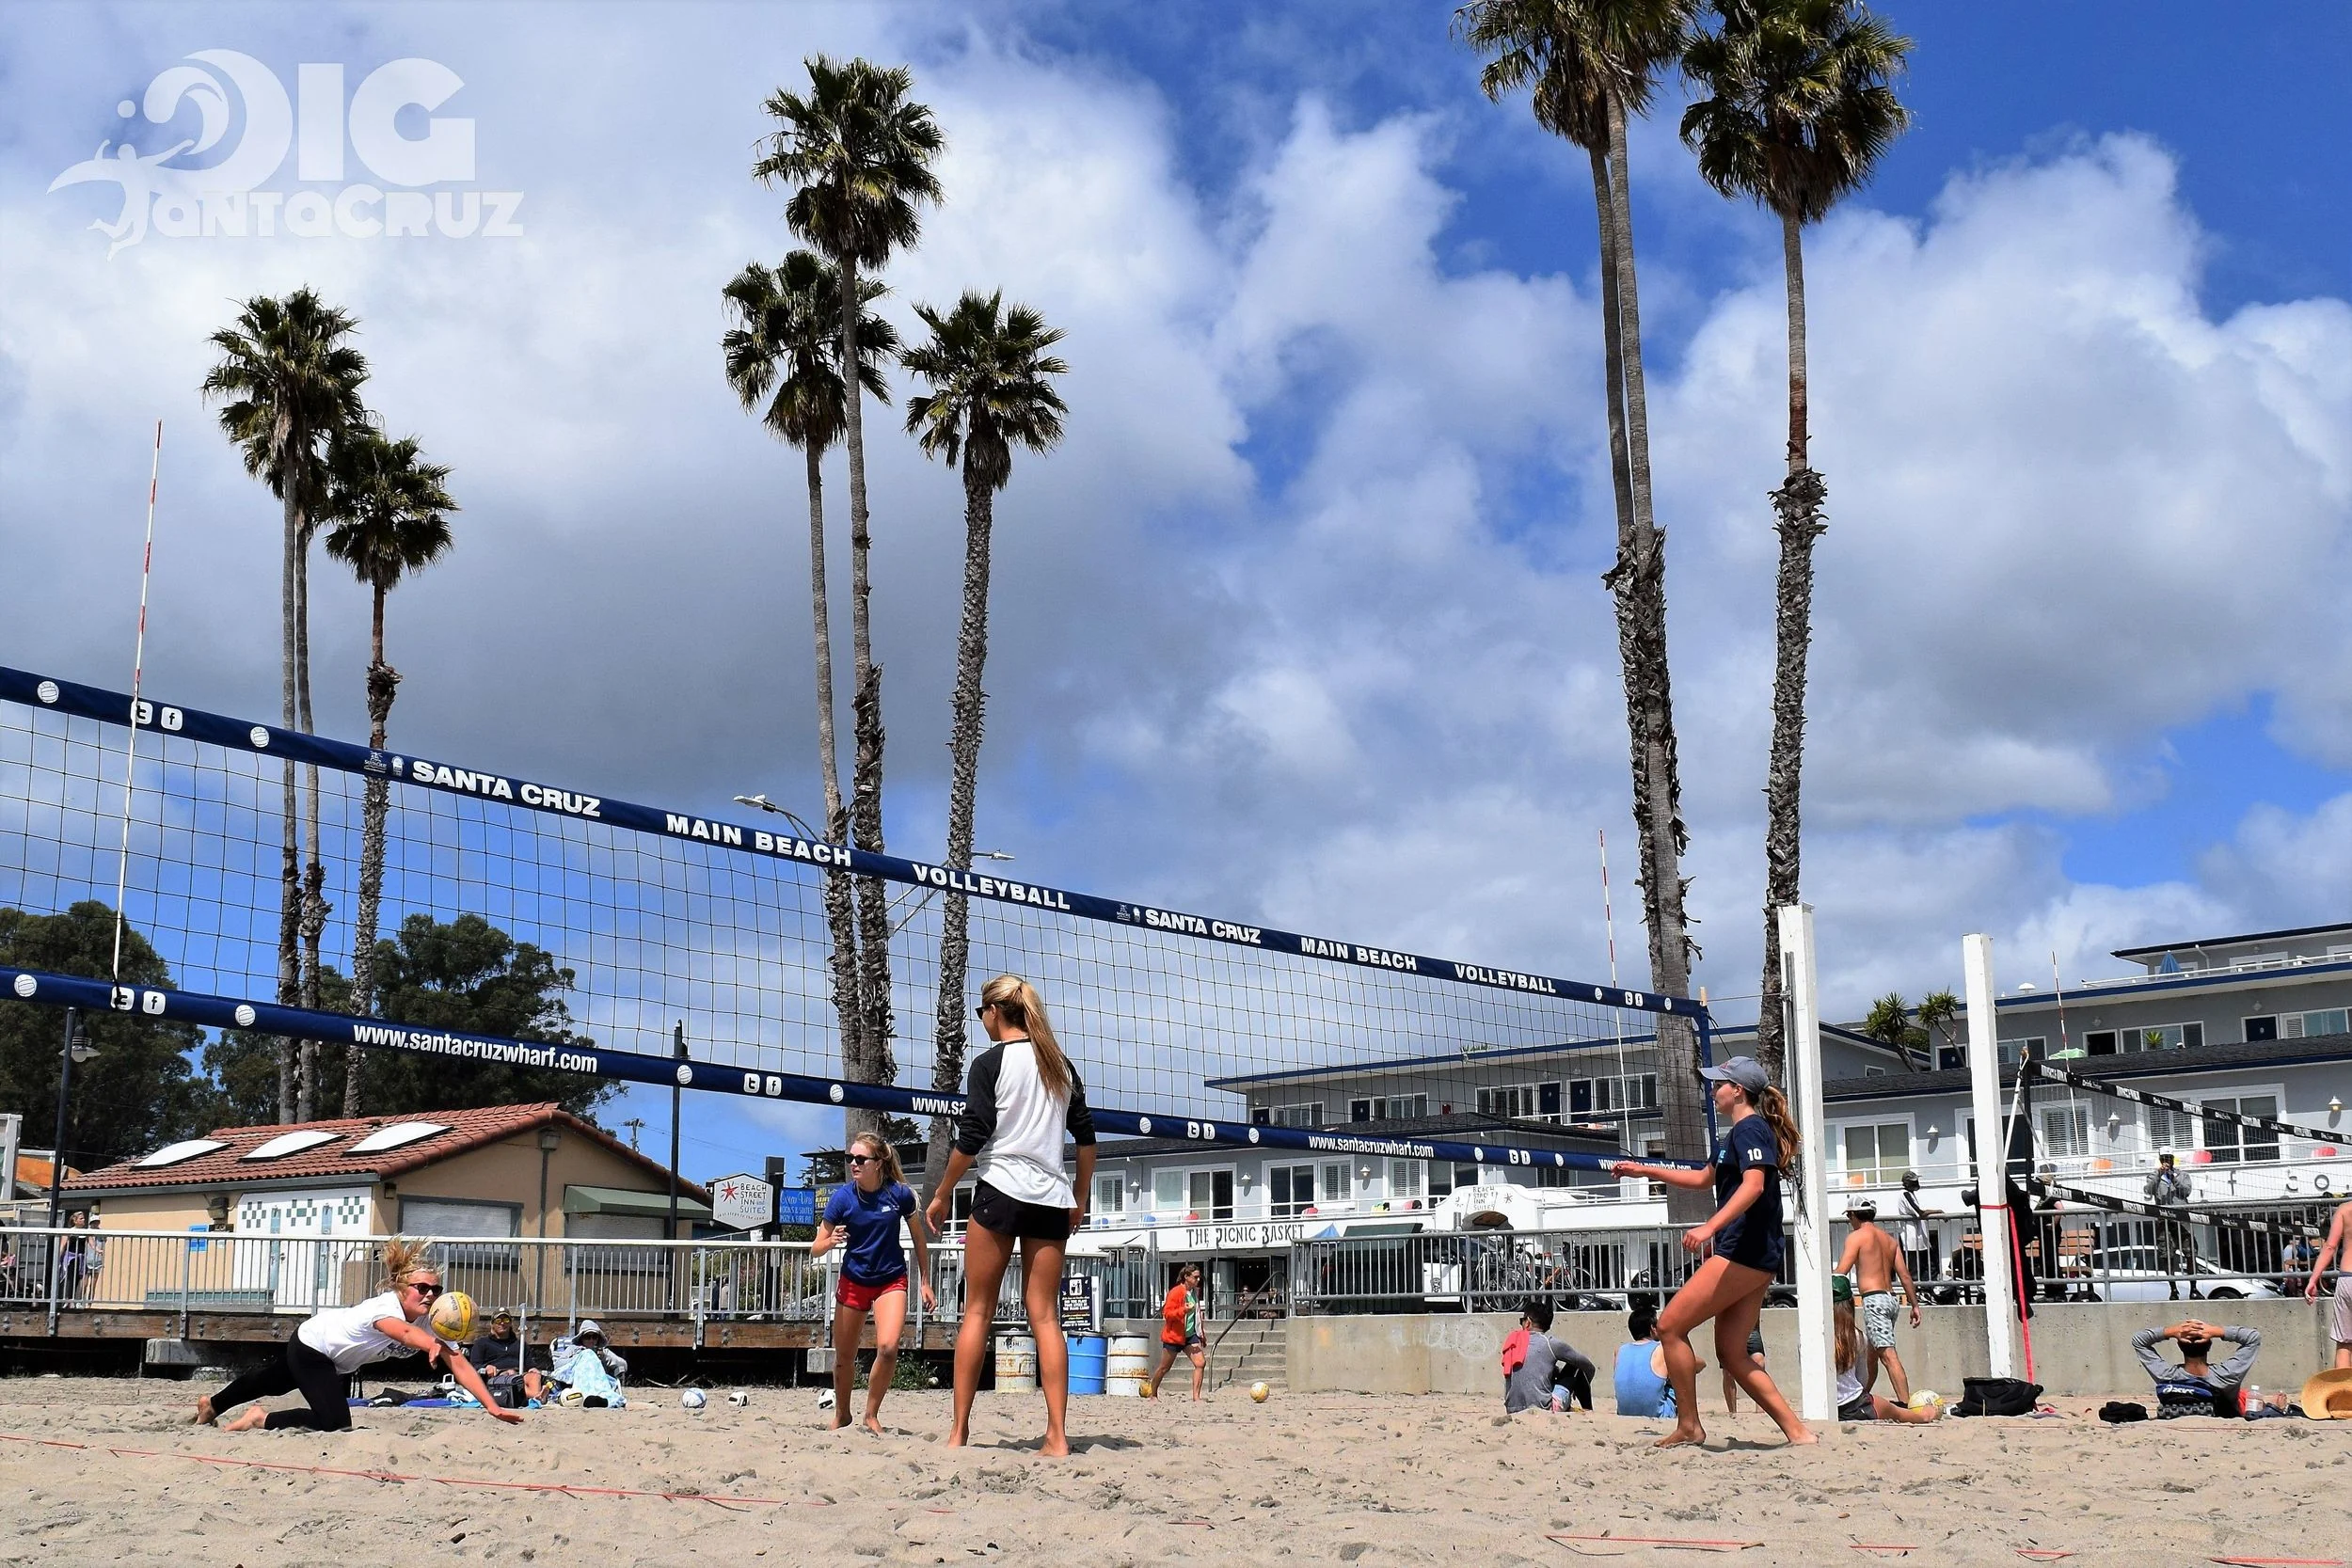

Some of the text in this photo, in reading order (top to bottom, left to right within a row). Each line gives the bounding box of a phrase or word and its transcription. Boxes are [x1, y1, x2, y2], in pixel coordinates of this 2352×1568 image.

[412, 761, 513, 800] SANTA
[520, 784, 600, 817] CRUZ
[666, 814, 741, 846] MAIN
[755, 832, 851, 867] BEACH
[912, 863, 1071, 911] VOLLEYBALL
[1145, 909, 1208, 934] SANTA
[1212, 921, 1261, 943] CRUZ
[1301, 938, 1348, 959] MAIN
[1356, 946, 1417, 971] BEACH
[1454, 963, 1556, 993] VOLLEYBALL
[353, 1024, 597, 1073] www.santacruzwharf.com
[1309, 1135, 1434, 1158] www.santacruzwharf.com
[1747, 1148, 1762, 1161] 10
[739, 1206, 766, 1214] SUITES
[1186, 1224, 1305, 1249] THE PICNIC BASKET
